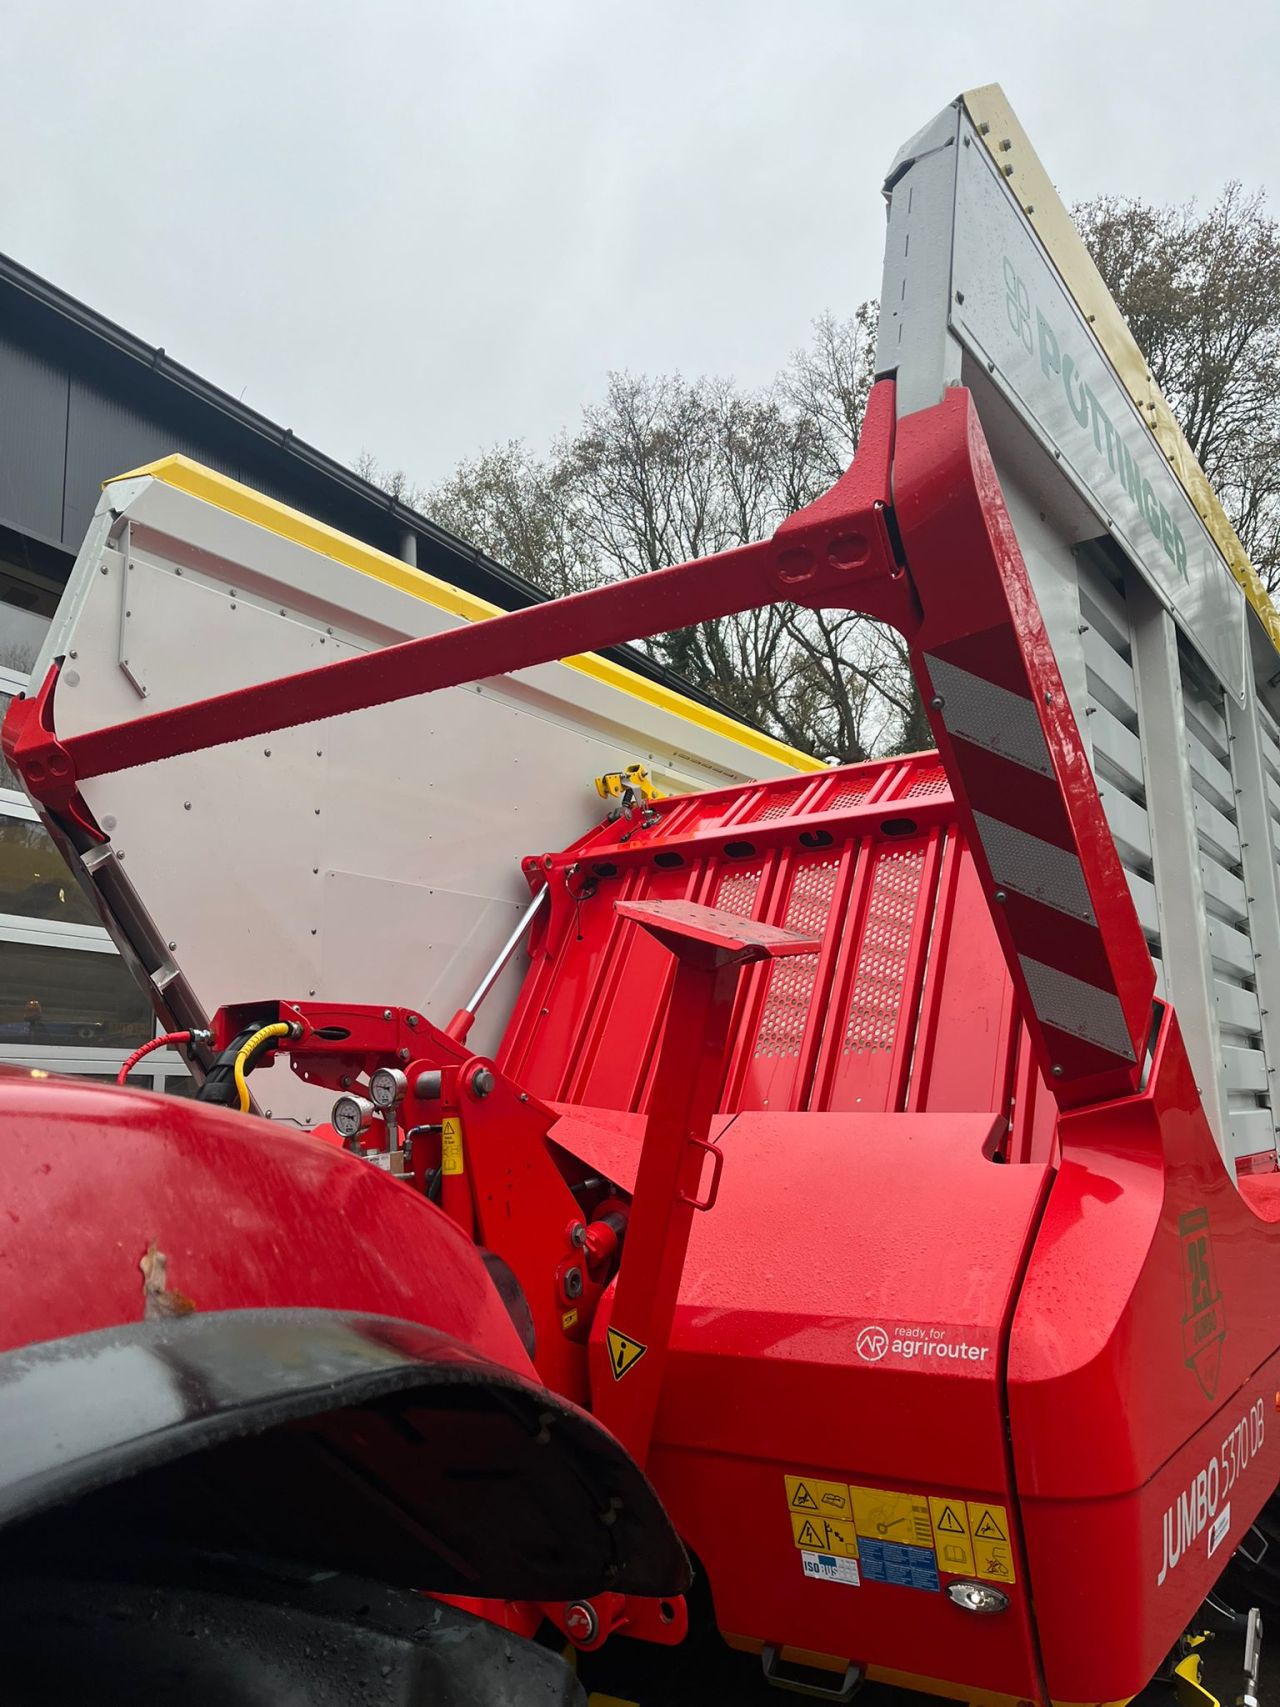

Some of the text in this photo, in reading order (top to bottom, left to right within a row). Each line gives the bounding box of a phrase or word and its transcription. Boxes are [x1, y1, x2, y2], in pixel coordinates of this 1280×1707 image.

[894, 1327, 945, 1339] ready for
[892, 1337, 989, 1360] agrirouter
[1157, 1398, 1264, 1586] JUMBO 5370 DB
